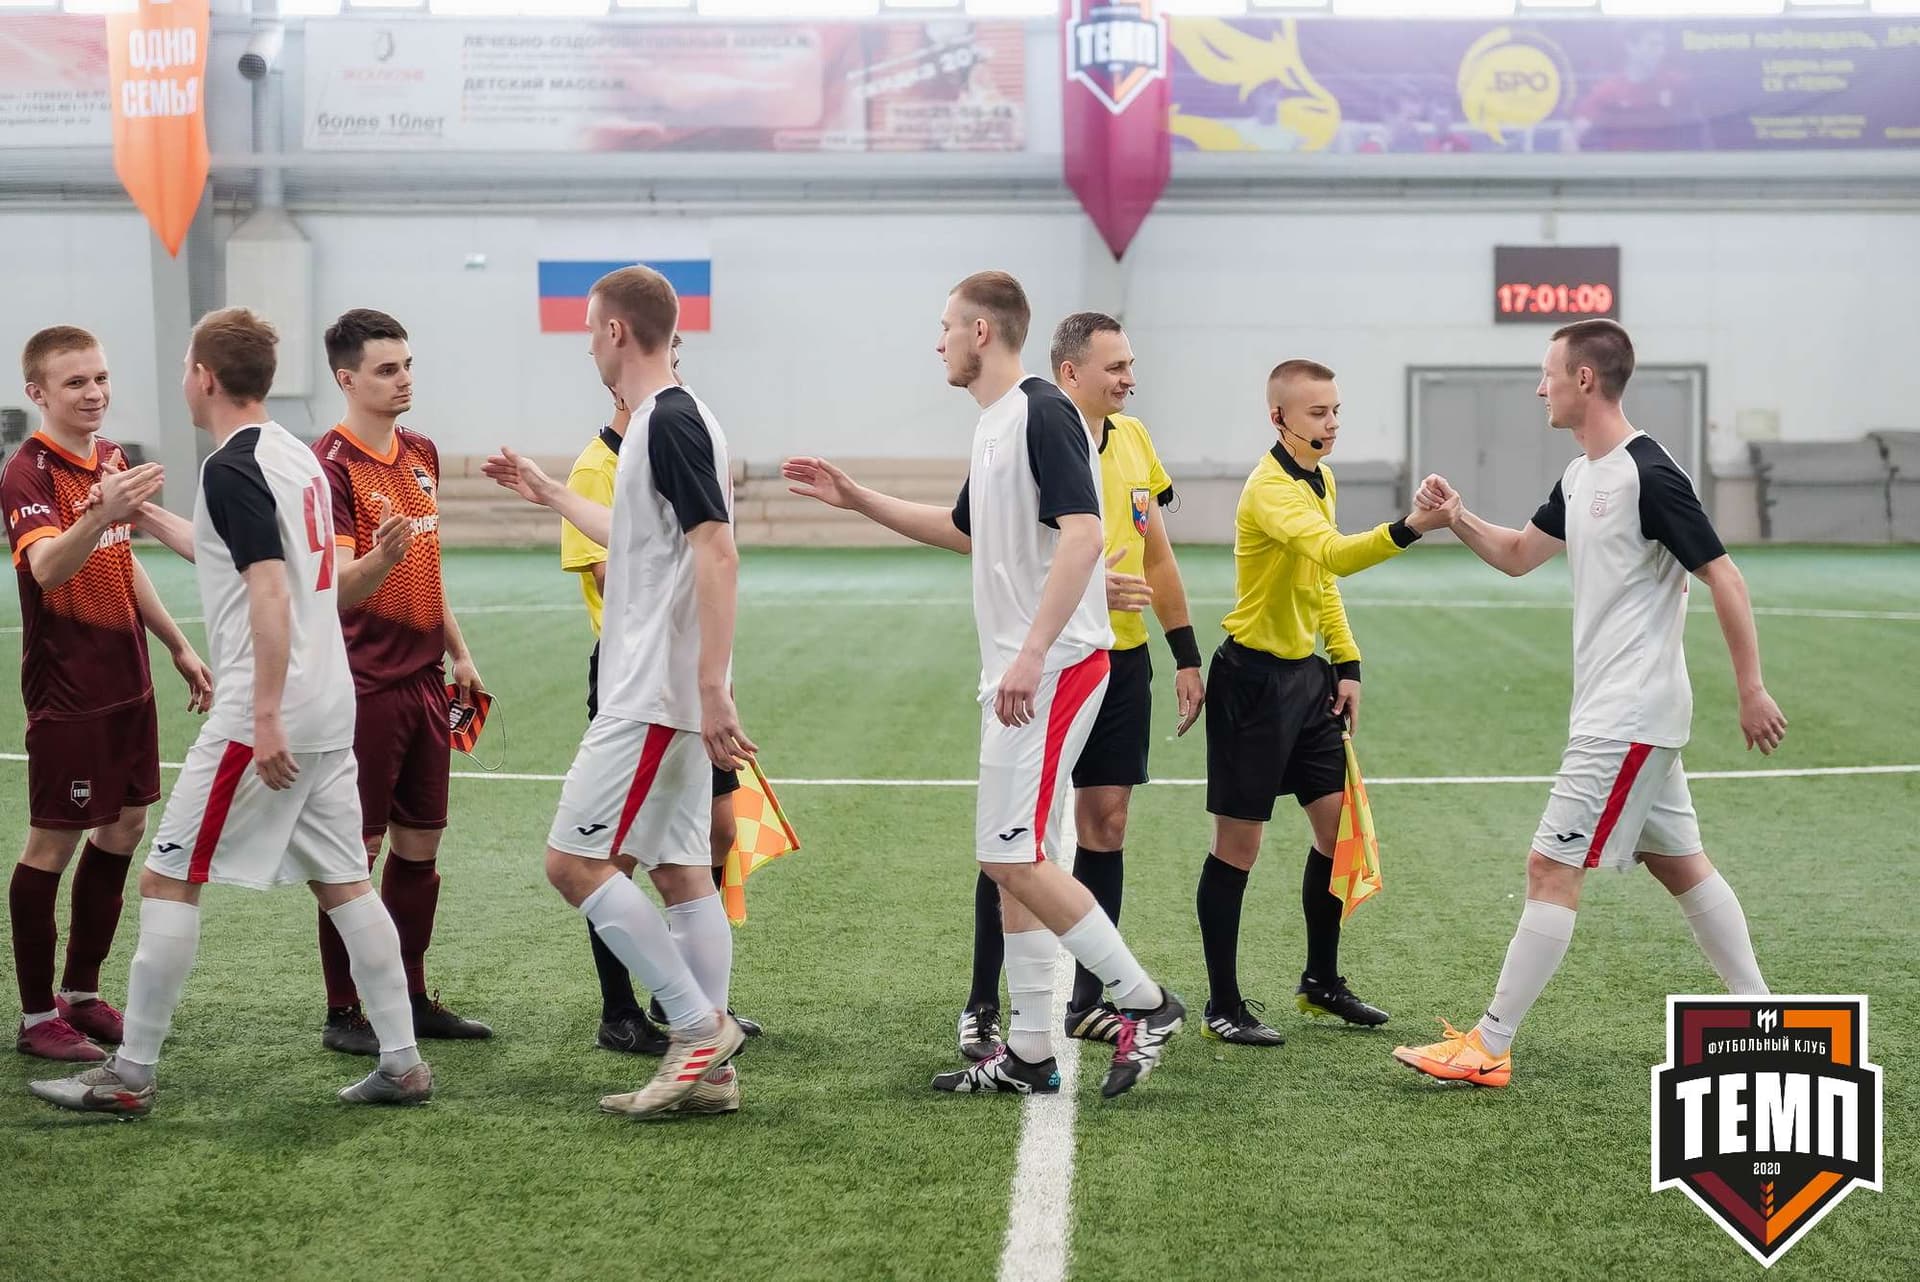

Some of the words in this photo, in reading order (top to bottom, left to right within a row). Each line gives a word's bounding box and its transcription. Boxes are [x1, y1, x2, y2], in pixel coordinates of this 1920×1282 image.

[129, 28, 196, 71] ОДНА
[121, 76, 198, 118] СЕМЬЯ
[1498, 283, 1612, 313] 17:01:09
[302, 476, 334, 592] 4
